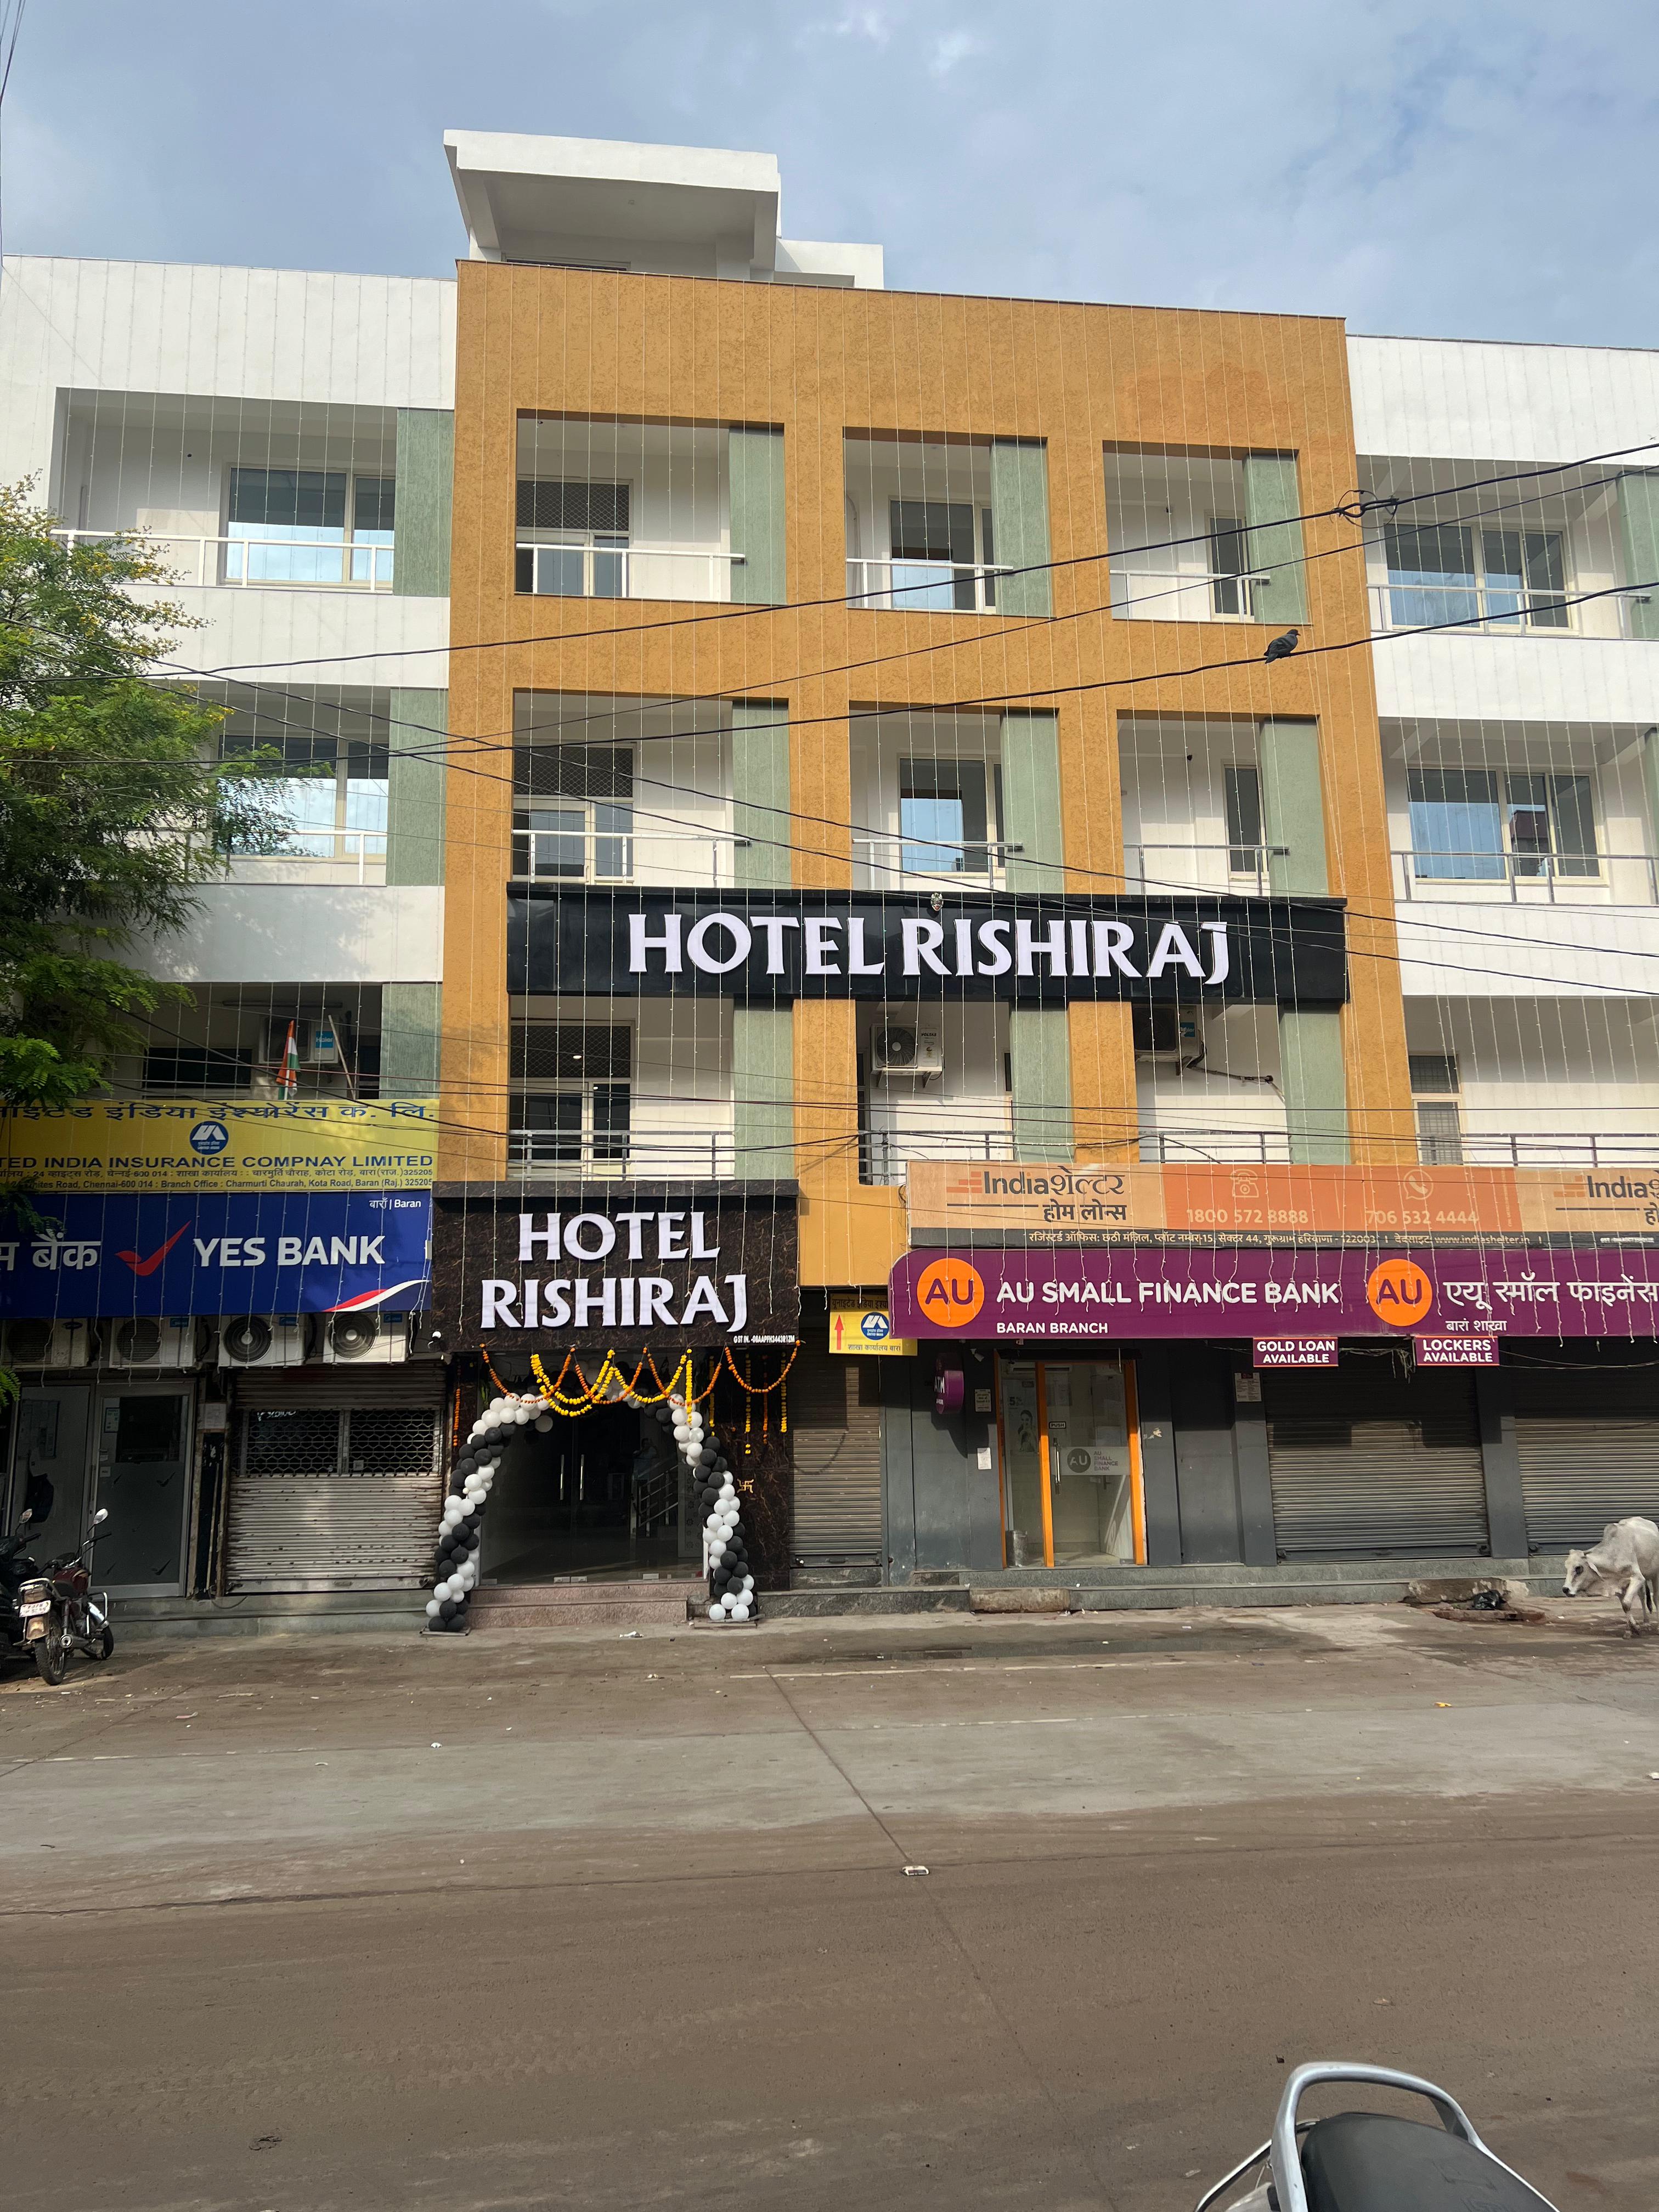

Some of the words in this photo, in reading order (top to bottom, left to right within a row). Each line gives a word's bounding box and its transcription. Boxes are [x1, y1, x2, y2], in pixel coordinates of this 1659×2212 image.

[629, 912, 885, 976] HOTEL
[903, 917, 1228, 984] RISHIRAJ
[104, 1102, 198, 1120] इंडिया
[390, 1101, 434, 1118] लि.
[44, 1157, 103, 1168] INDIA
[110, 1156, 235, 1168] INSURANCE
[242, 1156, 346, 1167] COMPNAY
[353, 1155, 433, 1166] LIMITED
[202, 1168, 238, 1177] कार्यालय
[315, 1168, 335, 1176] कोटा
[56, 1181, 81, 1189] Road,
[83, 1180, 136, 1188] Chennai-600
[138, 1180, 153, 1188] 014
[161, 1180, 191, 1188] Branch
[226, 1180, 267, 1188] Charmurti
[269, 1179, 306, 1188] Chaurah,
[308, 1179, 328, 1187] Kota
[330, 1179, 353, 1187] Road,
[356, 1178, 379, 1187] Baran
[381, 1178, 403, 1188] (Raj.)
[394, 1199, 422, 1208] Baran
[1042, 1198, 1075, 1223] होम
[1080, 1198, 1127, 1221] लोन्स
[1187, 1209, 1228, 1223] 1800
[1234, 1209, 1263, 1223] 572
[1268, 1209, 1308, 1224] 8888
[1365, 1210, 1397, 1224] 706
[1402, 1210, 1432, 1224] 532
[1435, 1211, 1480, 1224] 4444
[518, 1211, 721, 1261] HOTEL
[1029, 1231, 1063, 1242] रजिस्टर्ड
[1065, 1230, 1100, 1243] ऑफिस:
[1102, 1231, 1121, 1243] छठी
[1154, 1230, 1176, 1243] प्लॉट
[1218, 1232, 1243, 1243] सेक्टर
[1245, 1233, 1262, 1244] 44,
[1297, 1232, 1333, 1244] हरियाणा
[30, 1227, 103, 1271] बैंक
[193, 1237, 266, 1267] YES
[276, 1235, 386, 1266] BANK
[924, 1278, 974, 1305] AU
[996, 1281, 1035, 1304] AU
[1042, 1281, 1132, 1304] SMALL
[1138, 1282, 1258, 1304] FINANCE
[1264, 1282, 1340, 1304] BANK
[1379, 1278, 1423, 1305] AU
[1443, 1282, 1493, 1310] एयू
[1493, 1272, 1561, 1302] स्मॉल
[480, 1274, 748, 1333] RISHIRAJ
[996, 1322, 1046, 1334] BARAN
[1050, 1322, 1108, 1334] BRANCH
[1445, 1317, 1470, 1332] बारां
[1473, 1319, 1508, 1332] शाखा
[865, 1342, 888, 1351] कार्यालय
[1256, 1340, 1295, 1352] GOLD
[1299, 1340, 1335, 1352] LOAN
[1423, 1339, 1491, 1352] LOCKERS
[1263, 1353, 1330, 1364] AVAILABLE
[1423, 1352, 1493, 1363] AVAILABLE
[934, 1376, 945, 1394] ATM
[1069, 1455, 1088, 1466] AU
